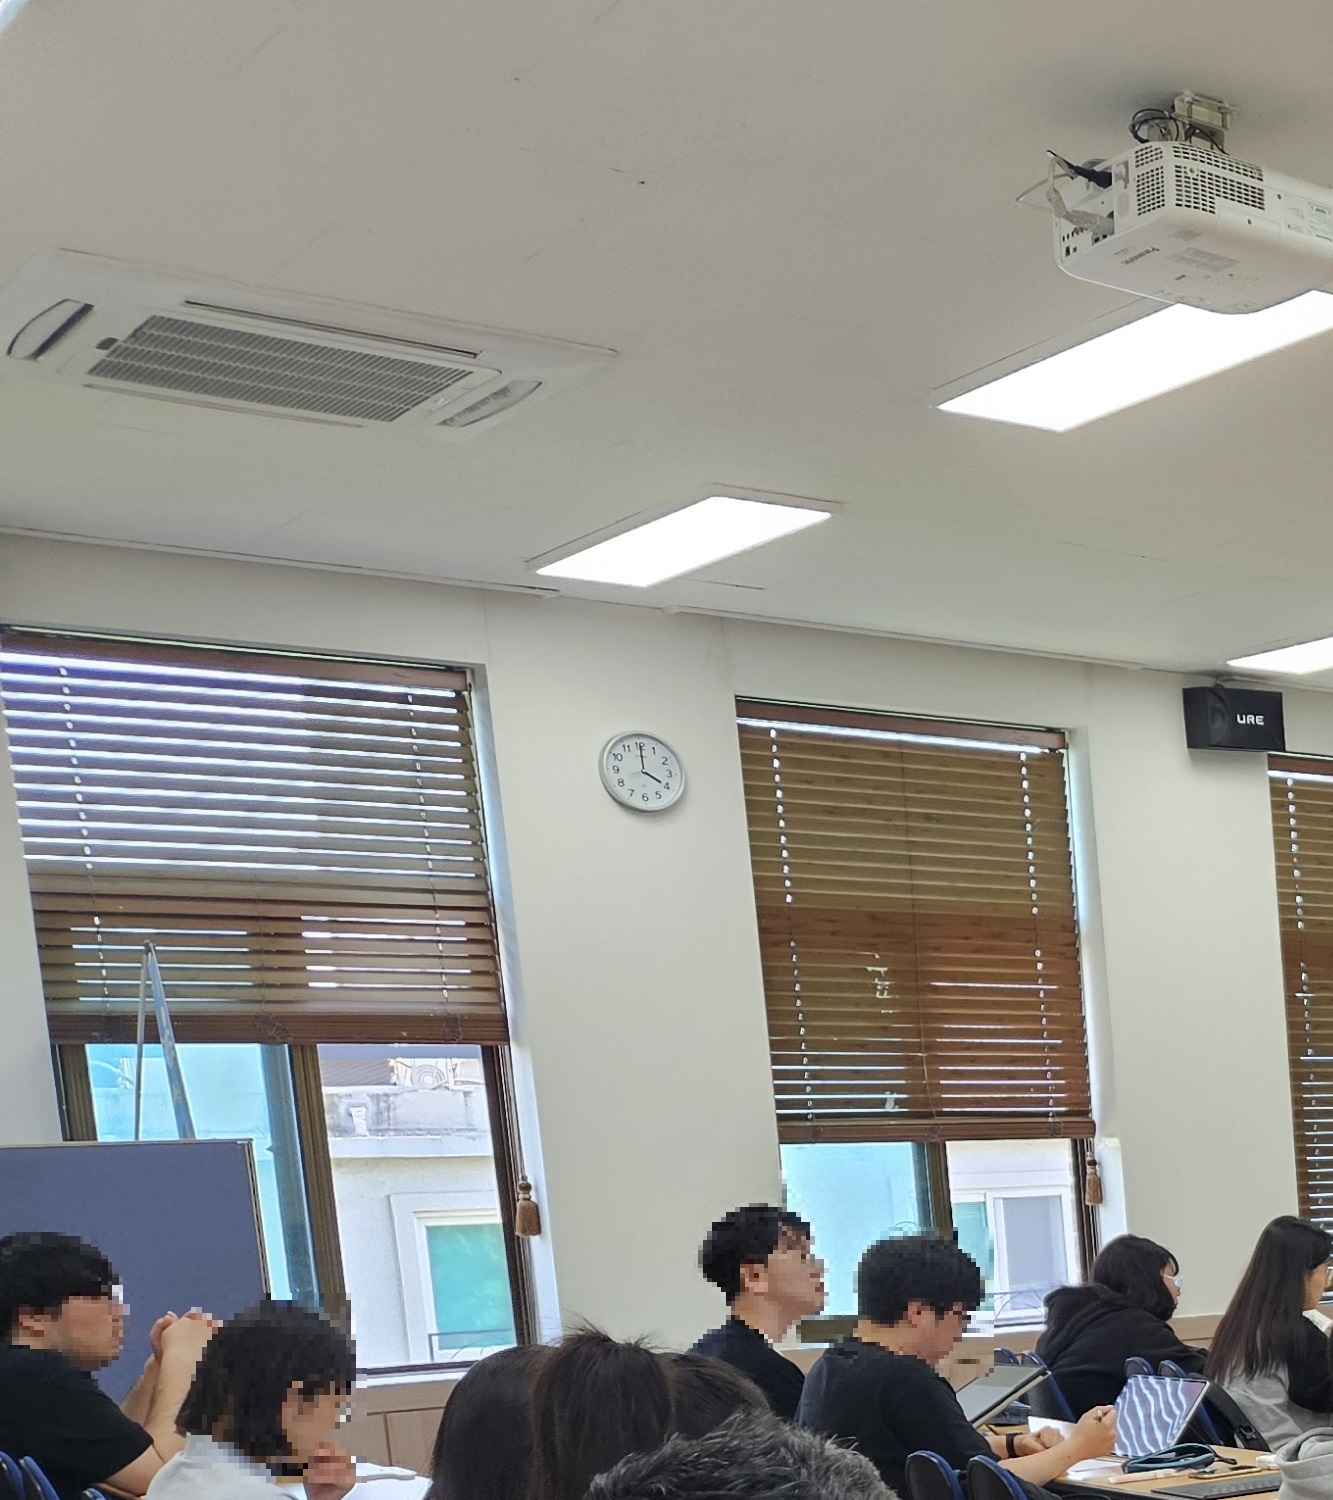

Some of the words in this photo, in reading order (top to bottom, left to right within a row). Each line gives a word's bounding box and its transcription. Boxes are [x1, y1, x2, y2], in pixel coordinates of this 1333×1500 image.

[622, 744, 631, 753] 11
[652, 746, 656, 755] 1
[612, 752, 623, 762] 10
[661, 756, 669, 765] 2
[612, 765, 620, 774] 9
[666, 769, 673, 778] 3
[617, 778, 625, 787] 8
[663, 782, 670, 790] 4
[628, 788, 635, 797] 7
[655, 790, 662, 799] 5
[641, 793, 649, 802] 6
